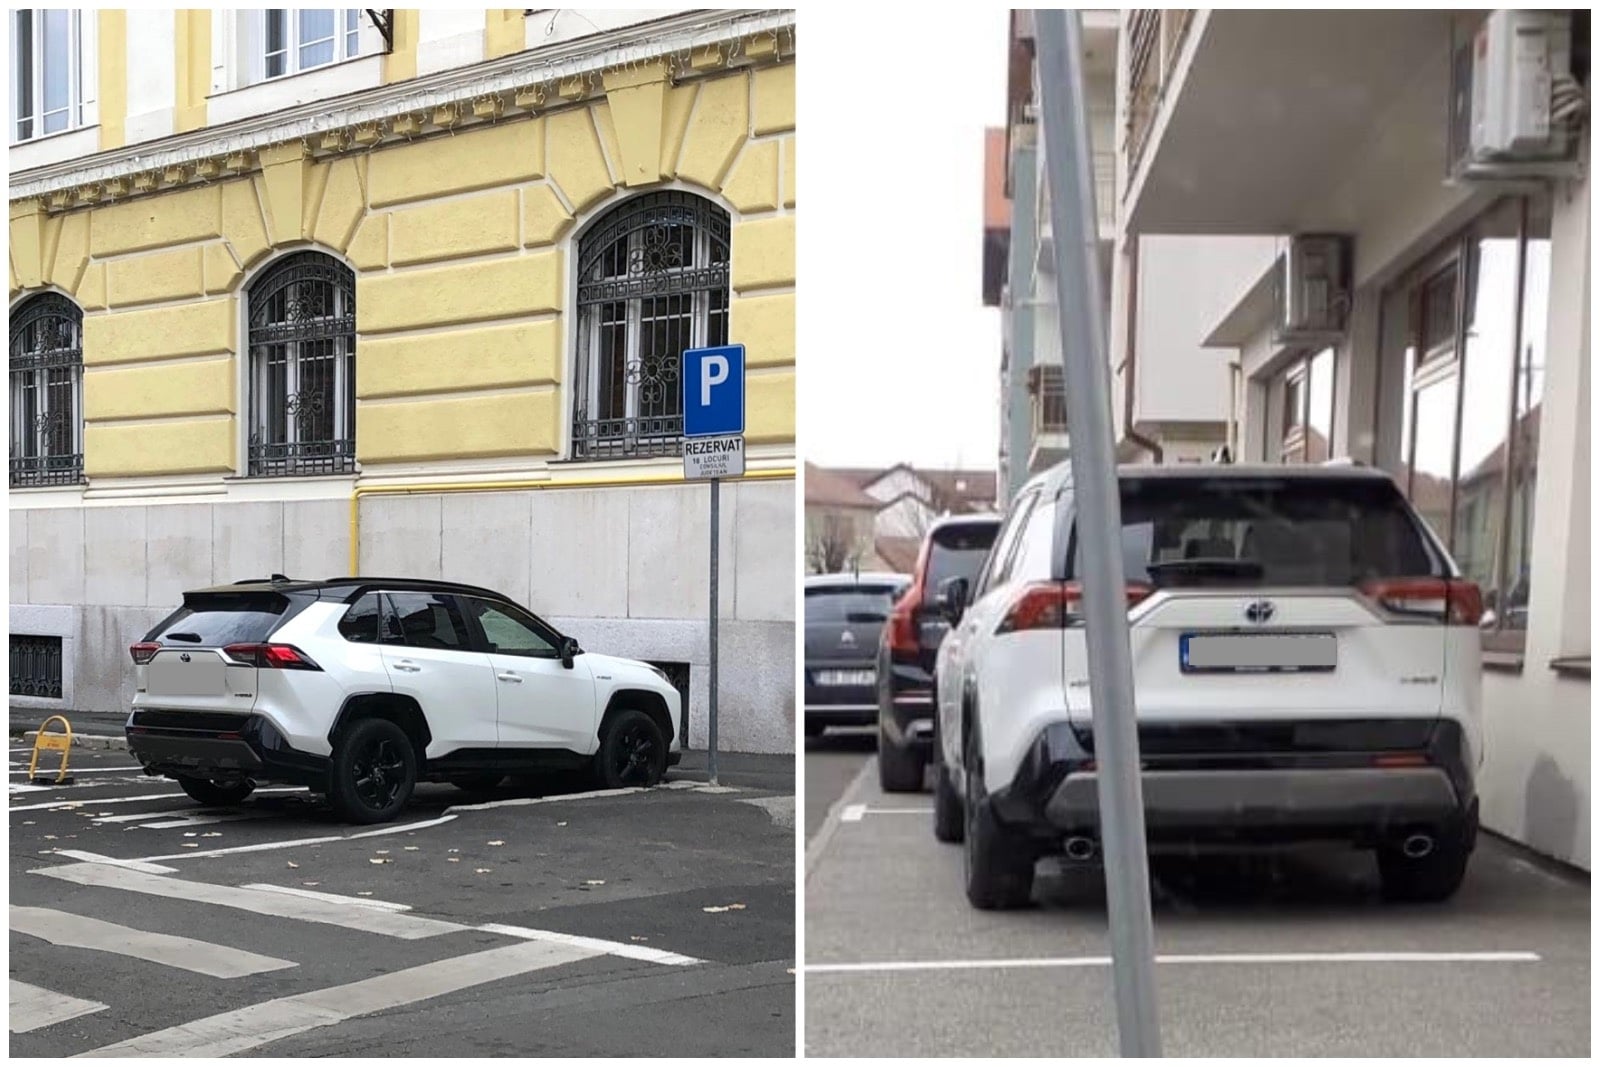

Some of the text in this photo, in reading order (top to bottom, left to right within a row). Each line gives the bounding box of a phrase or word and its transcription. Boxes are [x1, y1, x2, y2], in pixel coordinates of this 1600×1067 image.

[701, 354, 729, 407] P
[685, 438, 741, 456] REZERVAT
[704, 454, 729, 463] LOCURI
